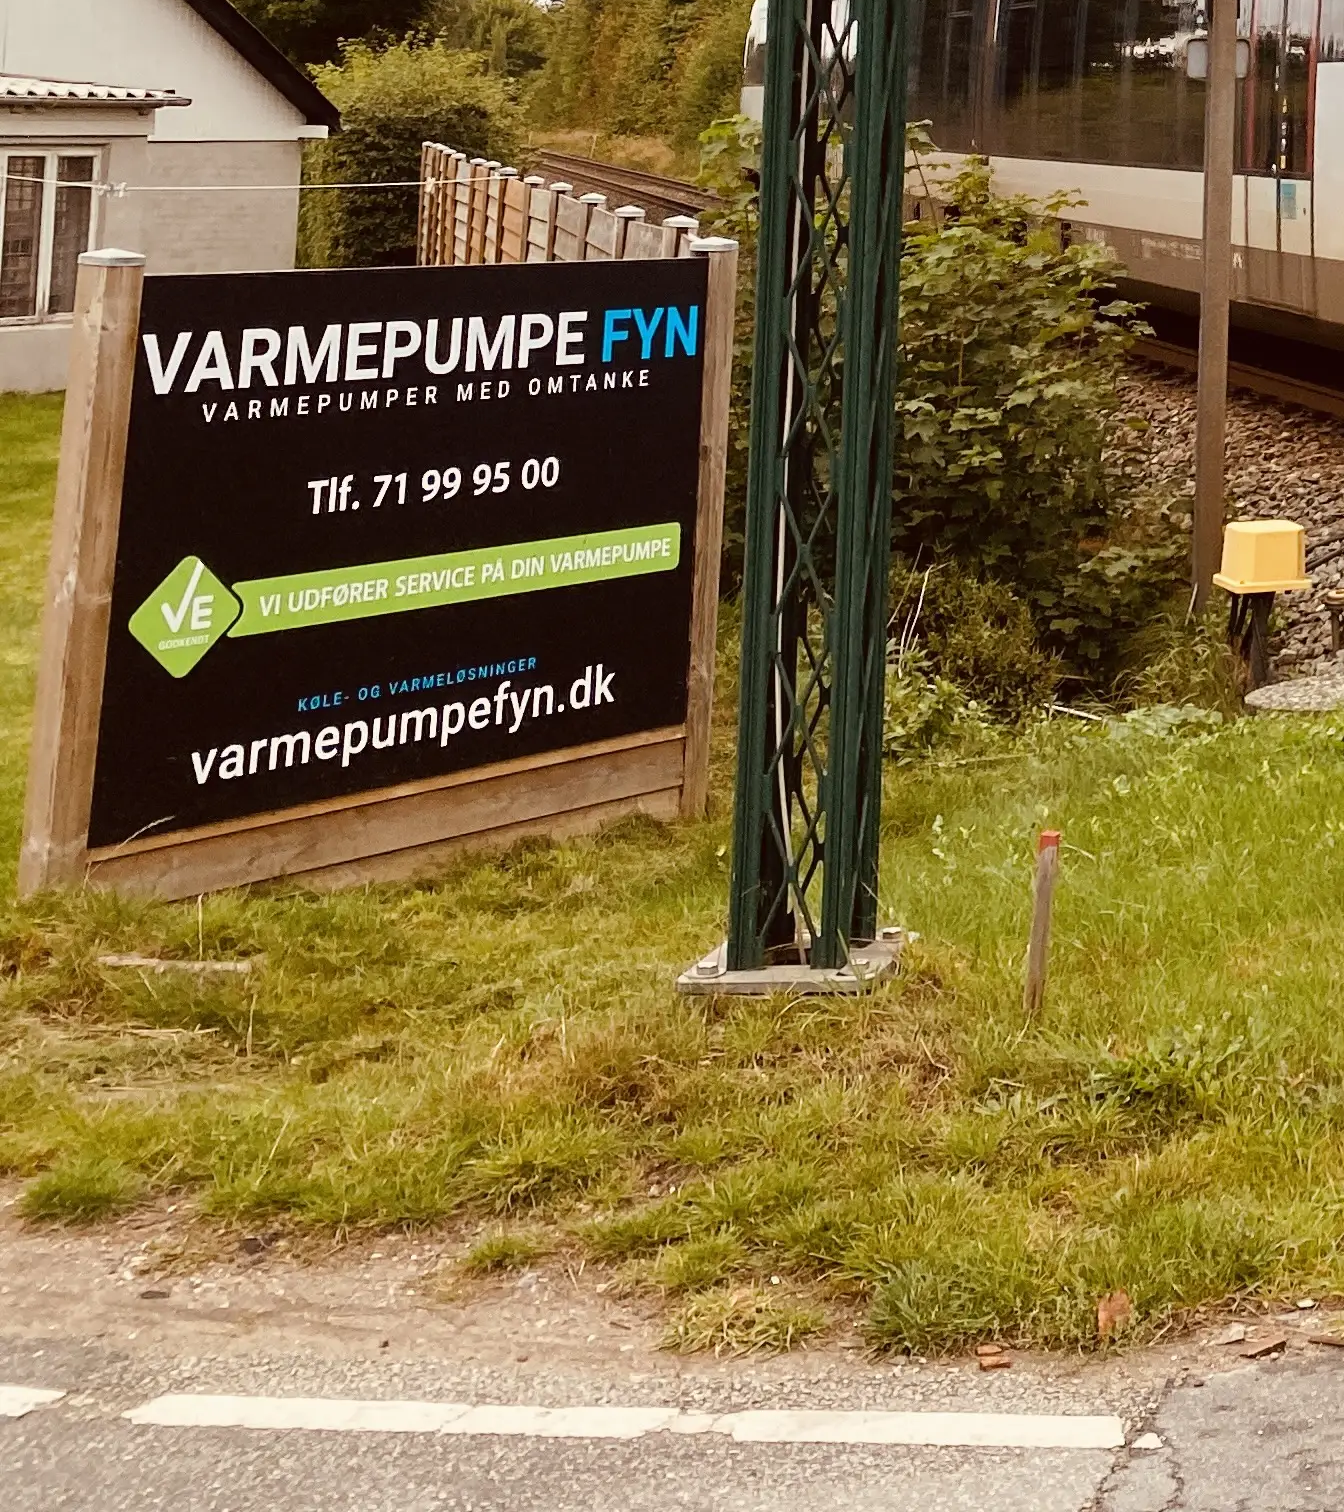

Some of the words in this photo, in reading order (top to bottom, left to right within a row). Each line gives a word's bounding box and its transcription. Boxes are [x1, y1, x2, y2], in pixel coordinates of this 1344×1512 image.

[142, 310, 588, 395] VARMEPUMPE
[602, 305, 699, 363] FYN
[202, 386, 438, 423] VARMEPUMPER
[456, 380, 511, 402] MED
[528, 369, 650, 396] OMTANKE
[307, 474, 361, 515] Tlf.
[372, 472, 408, 508] 71
[421, 467, 462, 503] 99
[472, 461, 511, 496] 95
[521, 456, 560, 490] 00
[259, 594, 281, 617] VI
[287, 578, 389, 613] UDFØRER
[395, 565, 476, 597] SERVICE
[481, 557, 505, 584] PÅ
[511, 555, 545, 580] DIN
[549, 538, 672, 574] VARMEPUMPE
[297, 690, 350, 712] KØLE-
[358, 685, 381, 701] OG
[389, 656, 537, 696] VARMELØSNINGER
[190, 663, 617, 785] varmepumpefyn.dk
